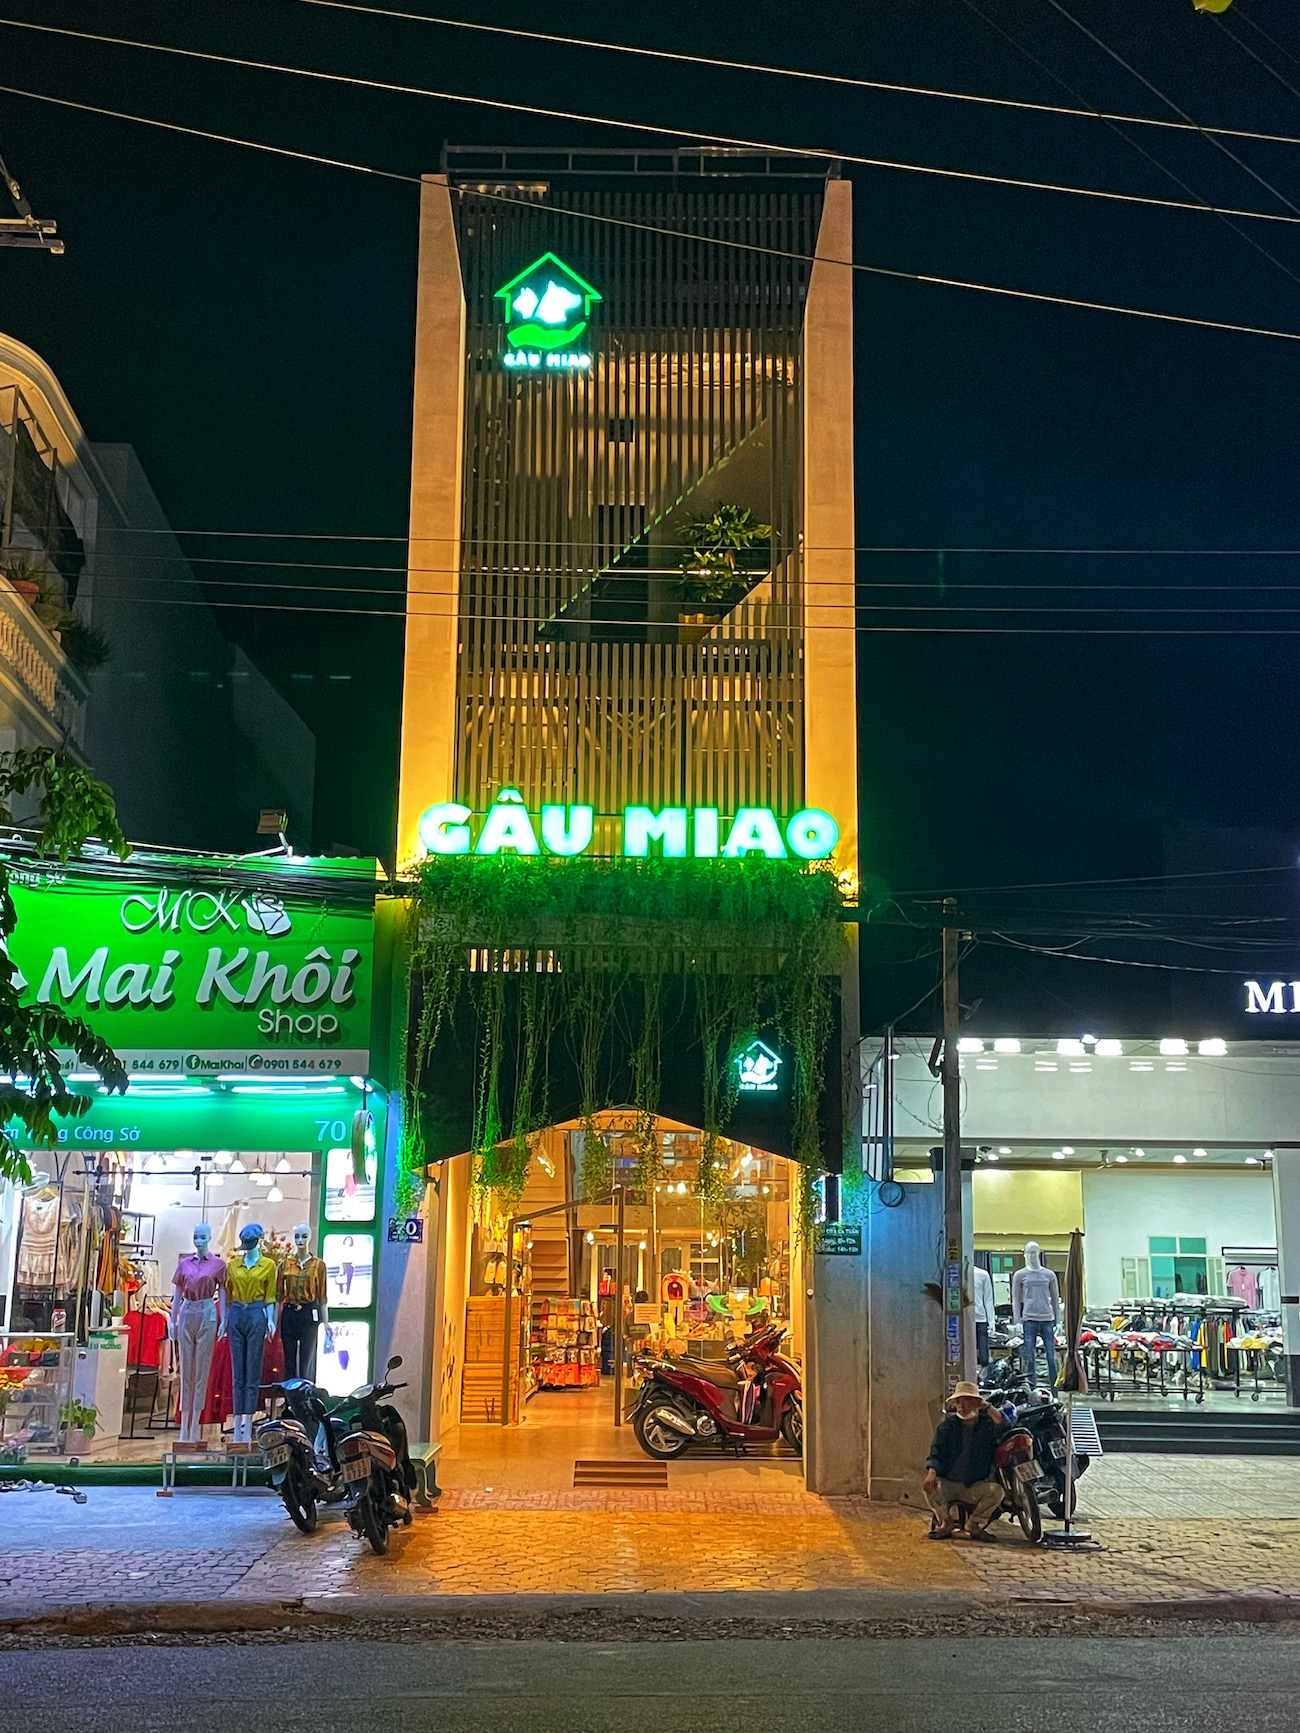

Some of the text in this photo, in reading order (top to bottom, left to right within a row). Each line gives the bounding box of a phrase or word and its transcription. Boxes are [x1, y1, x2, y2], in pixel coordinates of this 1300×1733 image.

[546, 353, 591, 368] MIAO
[419, 788, 839, 859] GÂU MIAO
[36, 946, 359, 1004] Mai Khôi
[257, 1008, 339, 1038] Shop
[132, 1060, 154, 1069] 544
[159, 1060, 180, 1069] 679
[263, 1060, 342, 1070] 0901 544 679
[74, 1126, 114, 1143] Công
[120, 1125, 141, 1141] Sở
[314, 1120, 347, 1142] 70
